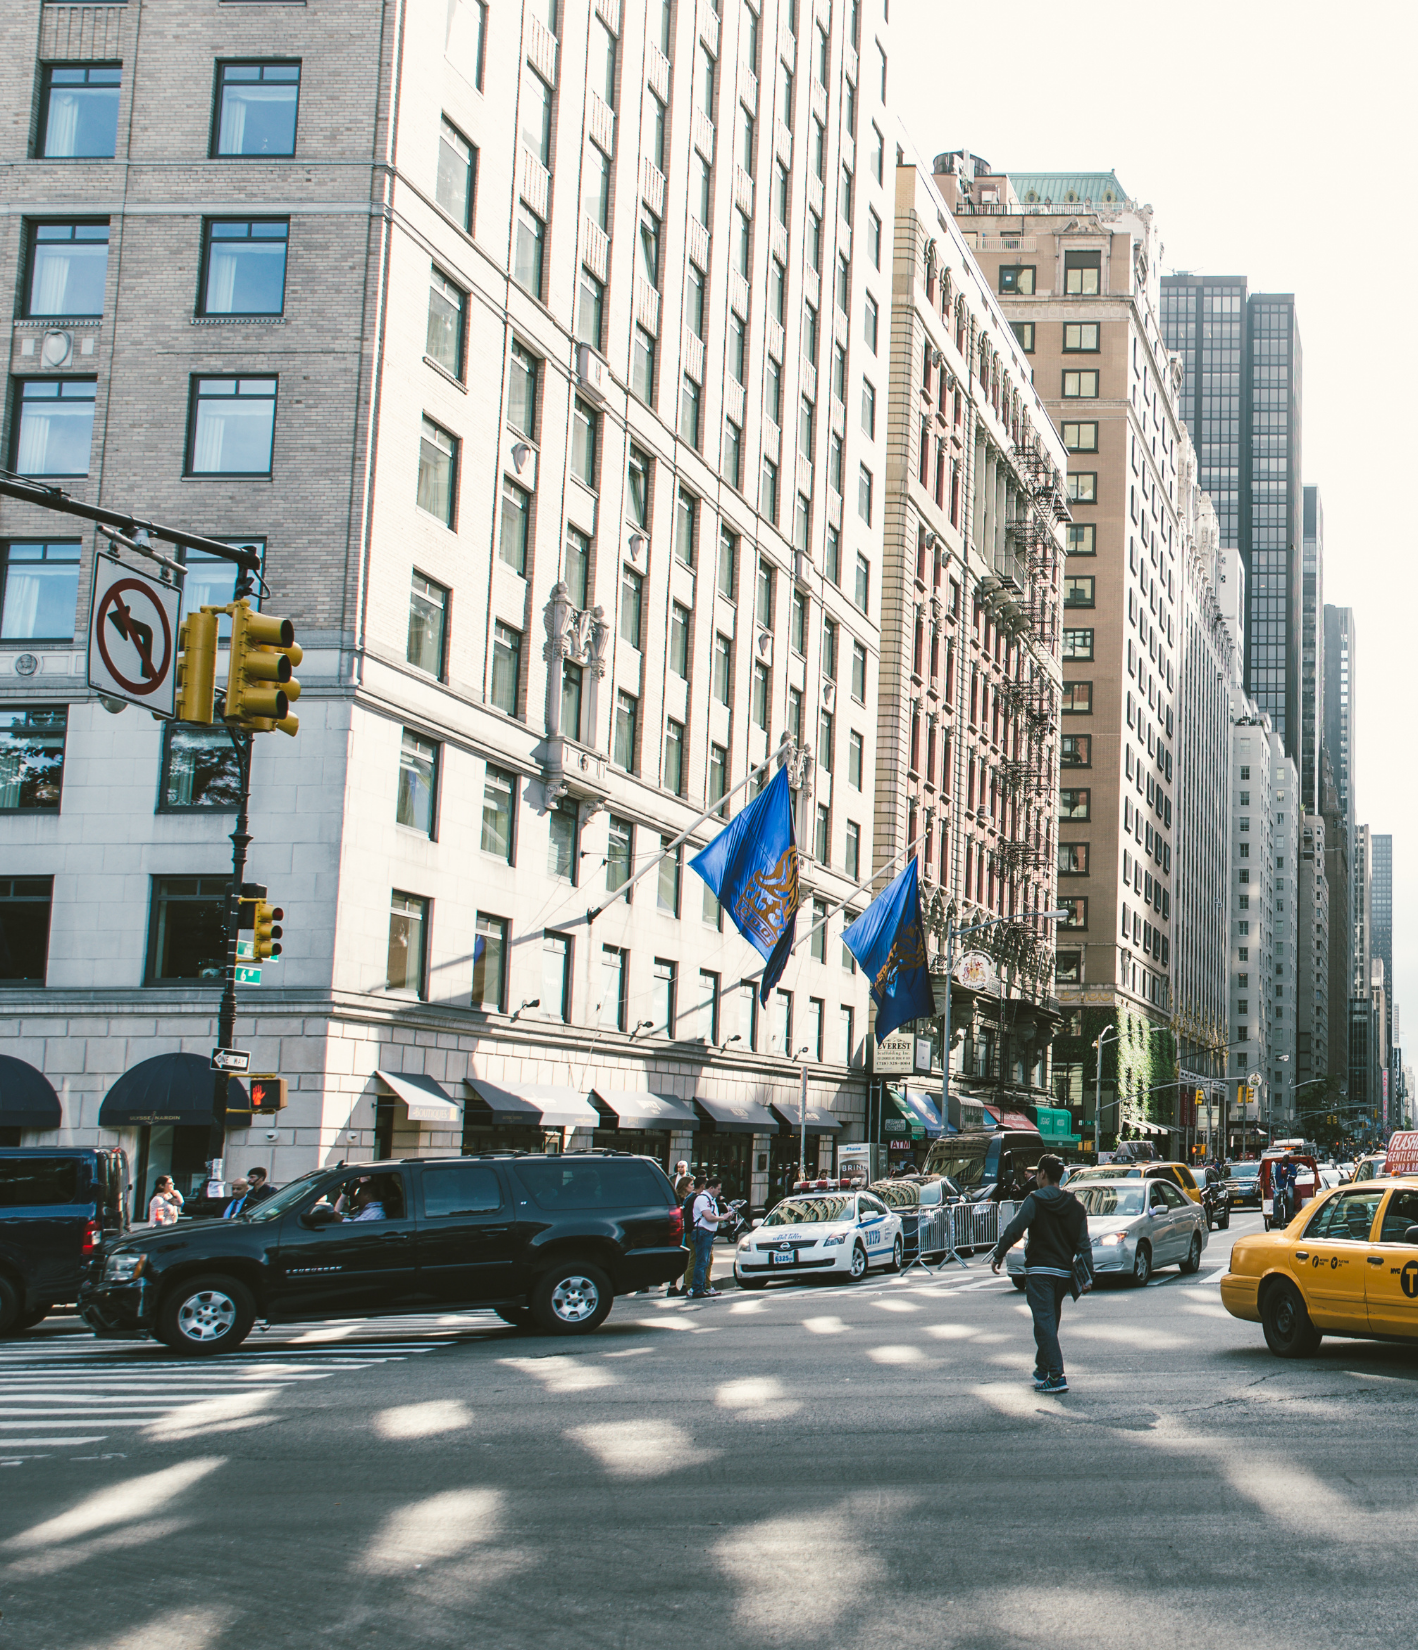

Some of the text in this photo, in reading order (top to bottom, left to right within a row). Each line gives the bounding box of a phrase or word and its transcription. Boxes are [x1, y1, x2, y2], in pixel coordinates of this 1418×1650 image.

[240, 970, 247, 981] 6
[877, 1042, 911, 1050] EVEREST
[218, 1055, 246, 1065] ONE WAY
[891, 1140, 910, 1149] ATM
[842, 1164, 869, 1172] BRING
[774, 1254, 789, 1262] 6325
[1390, 1267, 1418, 1294] NYC T
